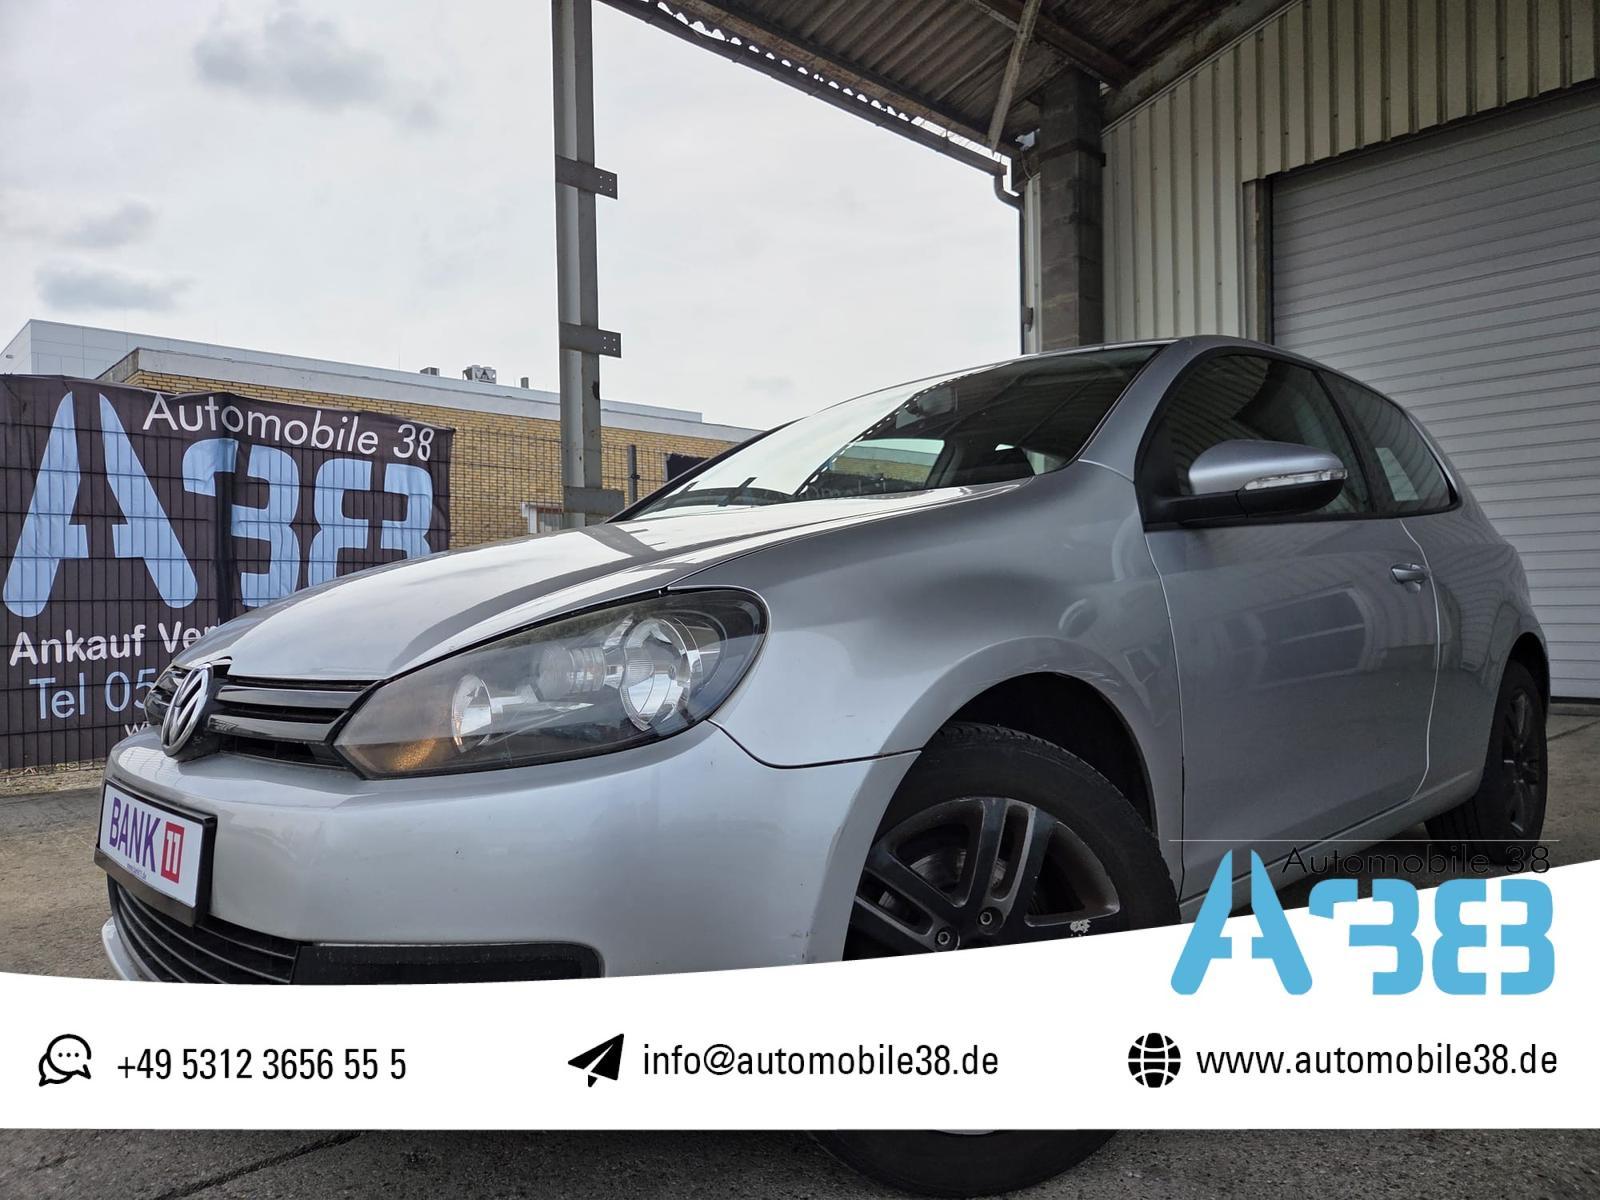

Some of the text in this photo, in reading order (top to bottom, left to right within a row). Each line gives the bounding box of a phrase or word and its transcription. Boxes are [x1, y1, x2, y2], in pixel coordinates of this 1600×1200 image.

[142, 391, 434, 462] Automobile 38
[9, 617, 220, 666] Ankauf Ver
[29, 672, 86, 720] Tel
[109, 797, 182, 875] BANK 11
